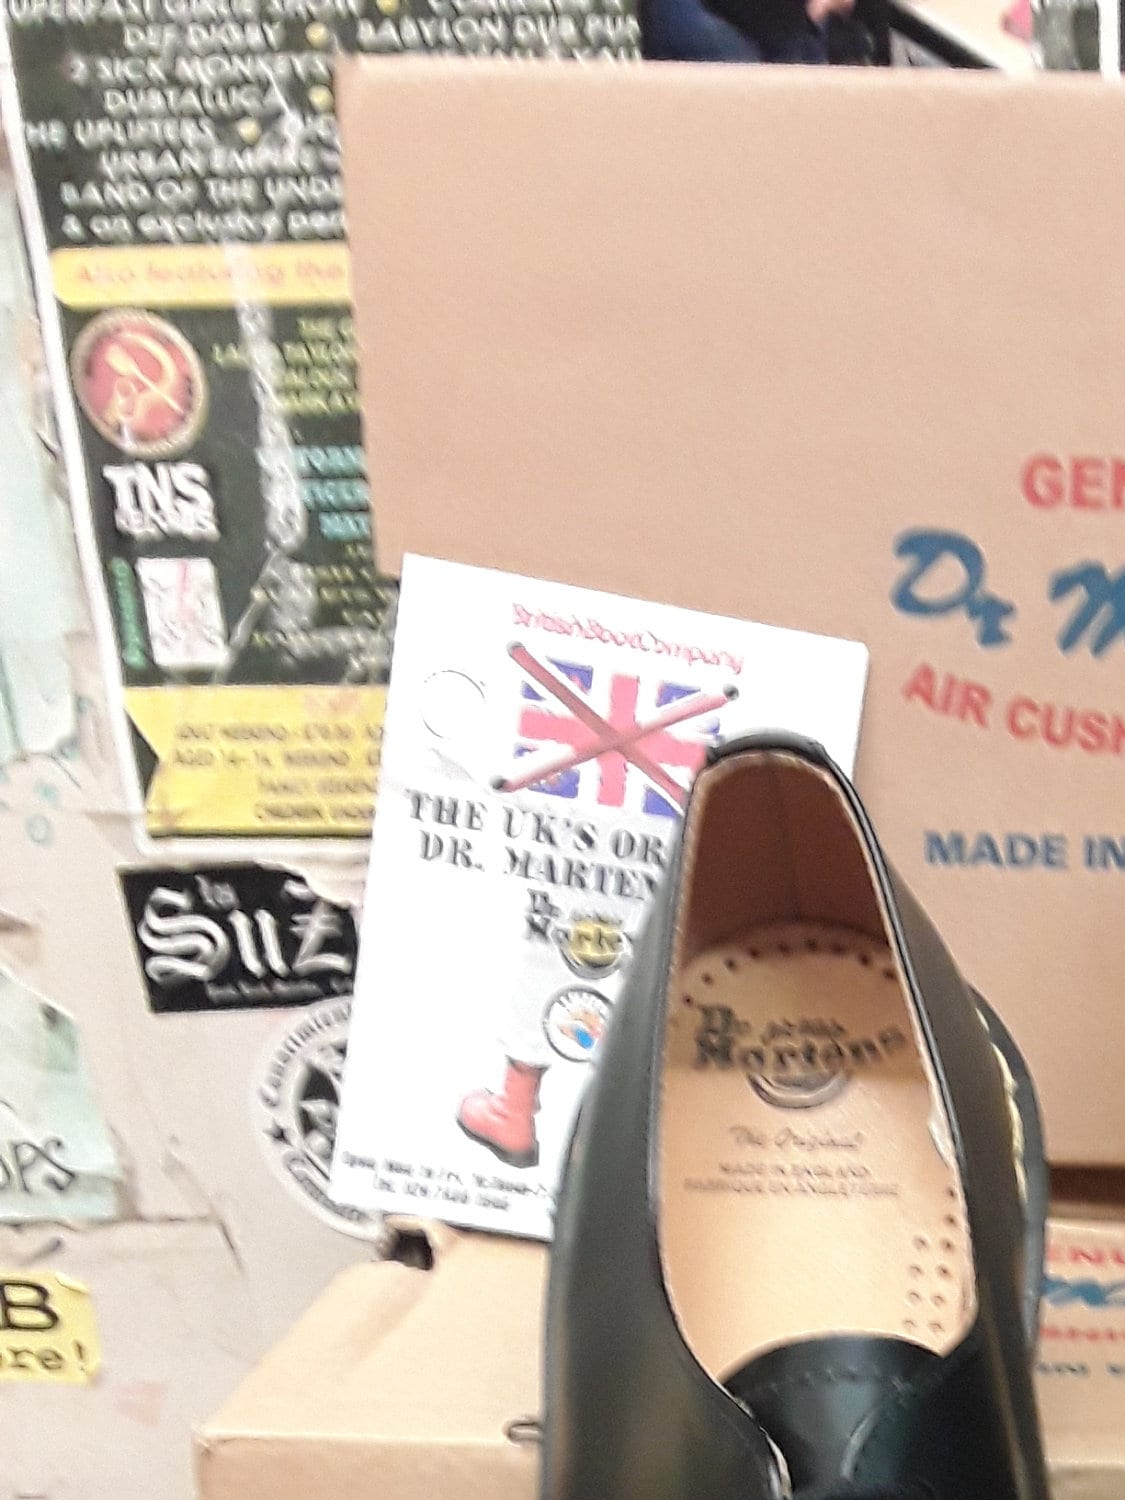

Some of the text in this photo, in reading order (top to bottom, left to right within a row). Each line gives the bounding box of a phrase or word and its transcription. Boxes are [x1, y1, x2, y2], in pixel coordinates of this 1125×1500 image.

[902, 664, 993, 728] AIR
[403, 788, 489, 832] THE
[502, 805, 599, 853] UK'S
[418, 829, 487, 873] DR.
[923, 832, 1069, 870] MADE
